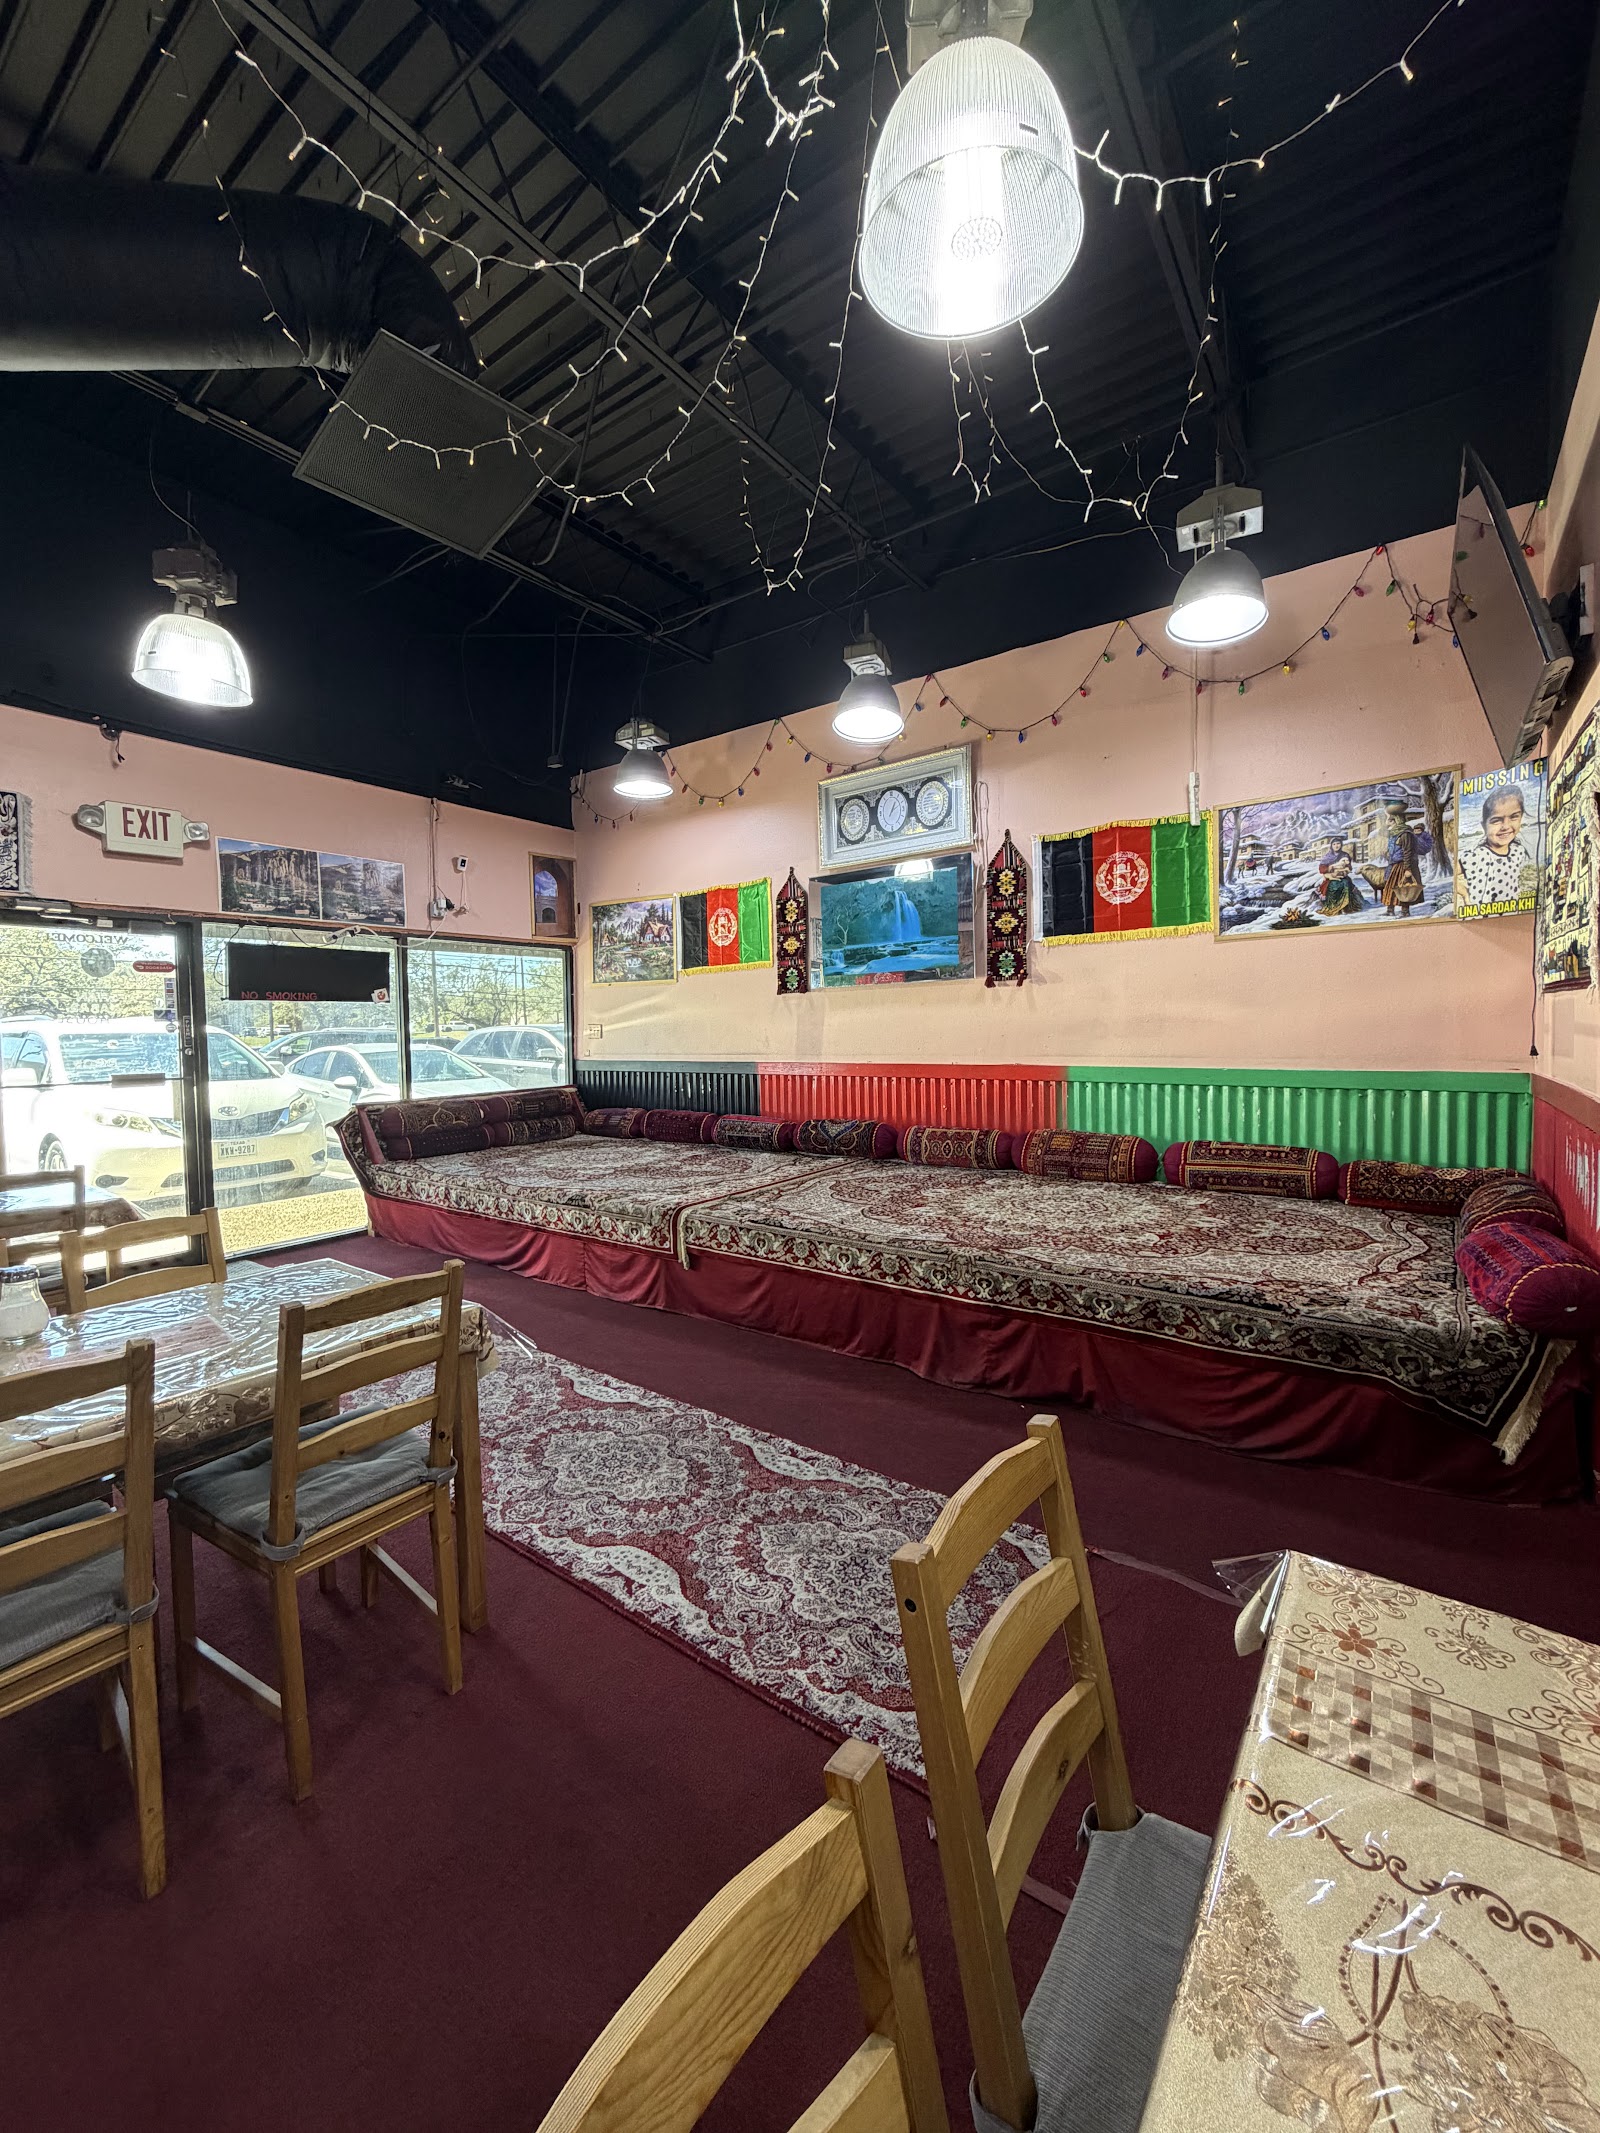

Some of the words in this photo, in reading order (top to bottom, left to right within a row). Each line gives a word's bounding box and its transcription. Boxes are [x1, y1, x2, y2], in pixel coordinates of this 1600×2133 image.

[1463, 761, 1543, 796] MISSING
[122, 807, 171, 841] EXIT
[1459, 904, 1478, 918] LINA
[1480, 900, 1516, 915] SARDAR
[1519, 897, 1541, 911] KHI
[241, 991, 259, 1000] NO
[265, 991, 318, 1000] SMOKING
